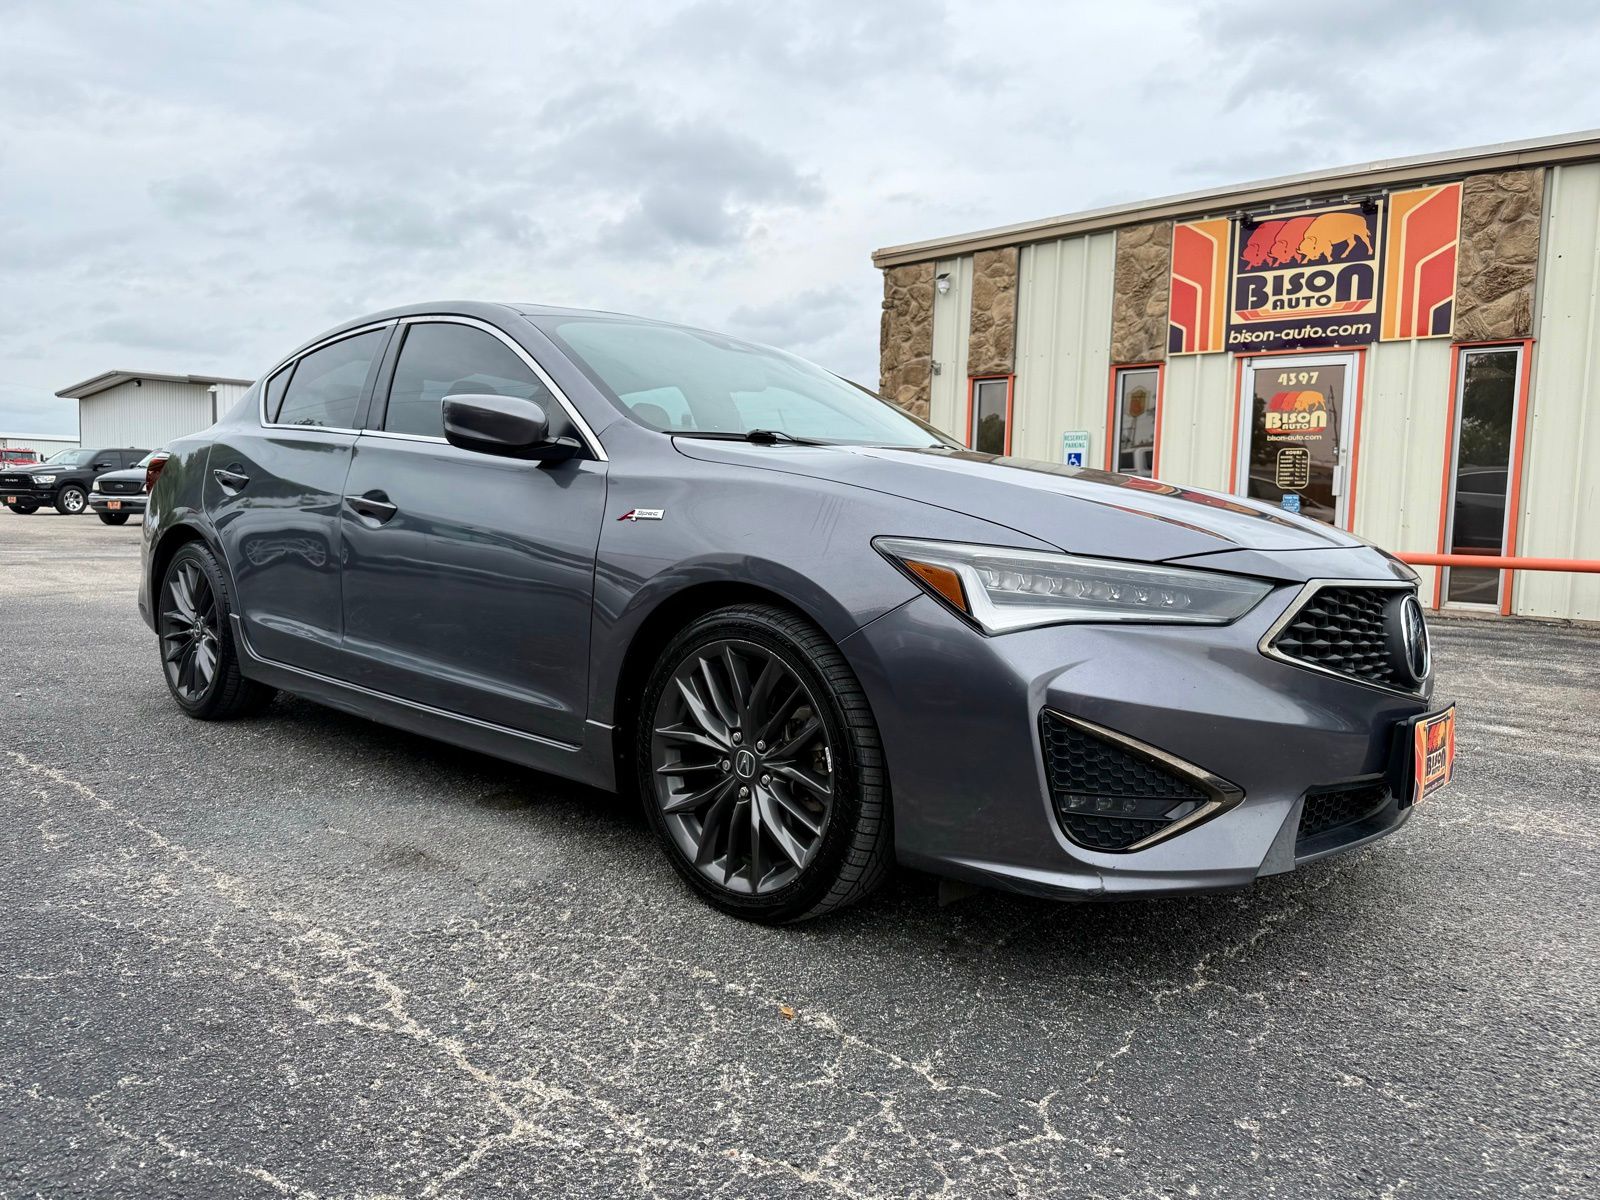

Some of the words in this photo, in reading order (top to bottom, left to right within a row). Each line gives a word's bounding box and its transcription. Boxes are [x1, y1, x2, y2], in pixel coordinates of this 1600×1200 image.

[1235, 263, 1374, 310] BISON
[1272, 295, 1332, 310] AUTO
[1229, 323, 1371, 344] bison-auto.com
[1277, 371, 1319, 386] 4397
[1265, 411, 1327, 429] BISON
